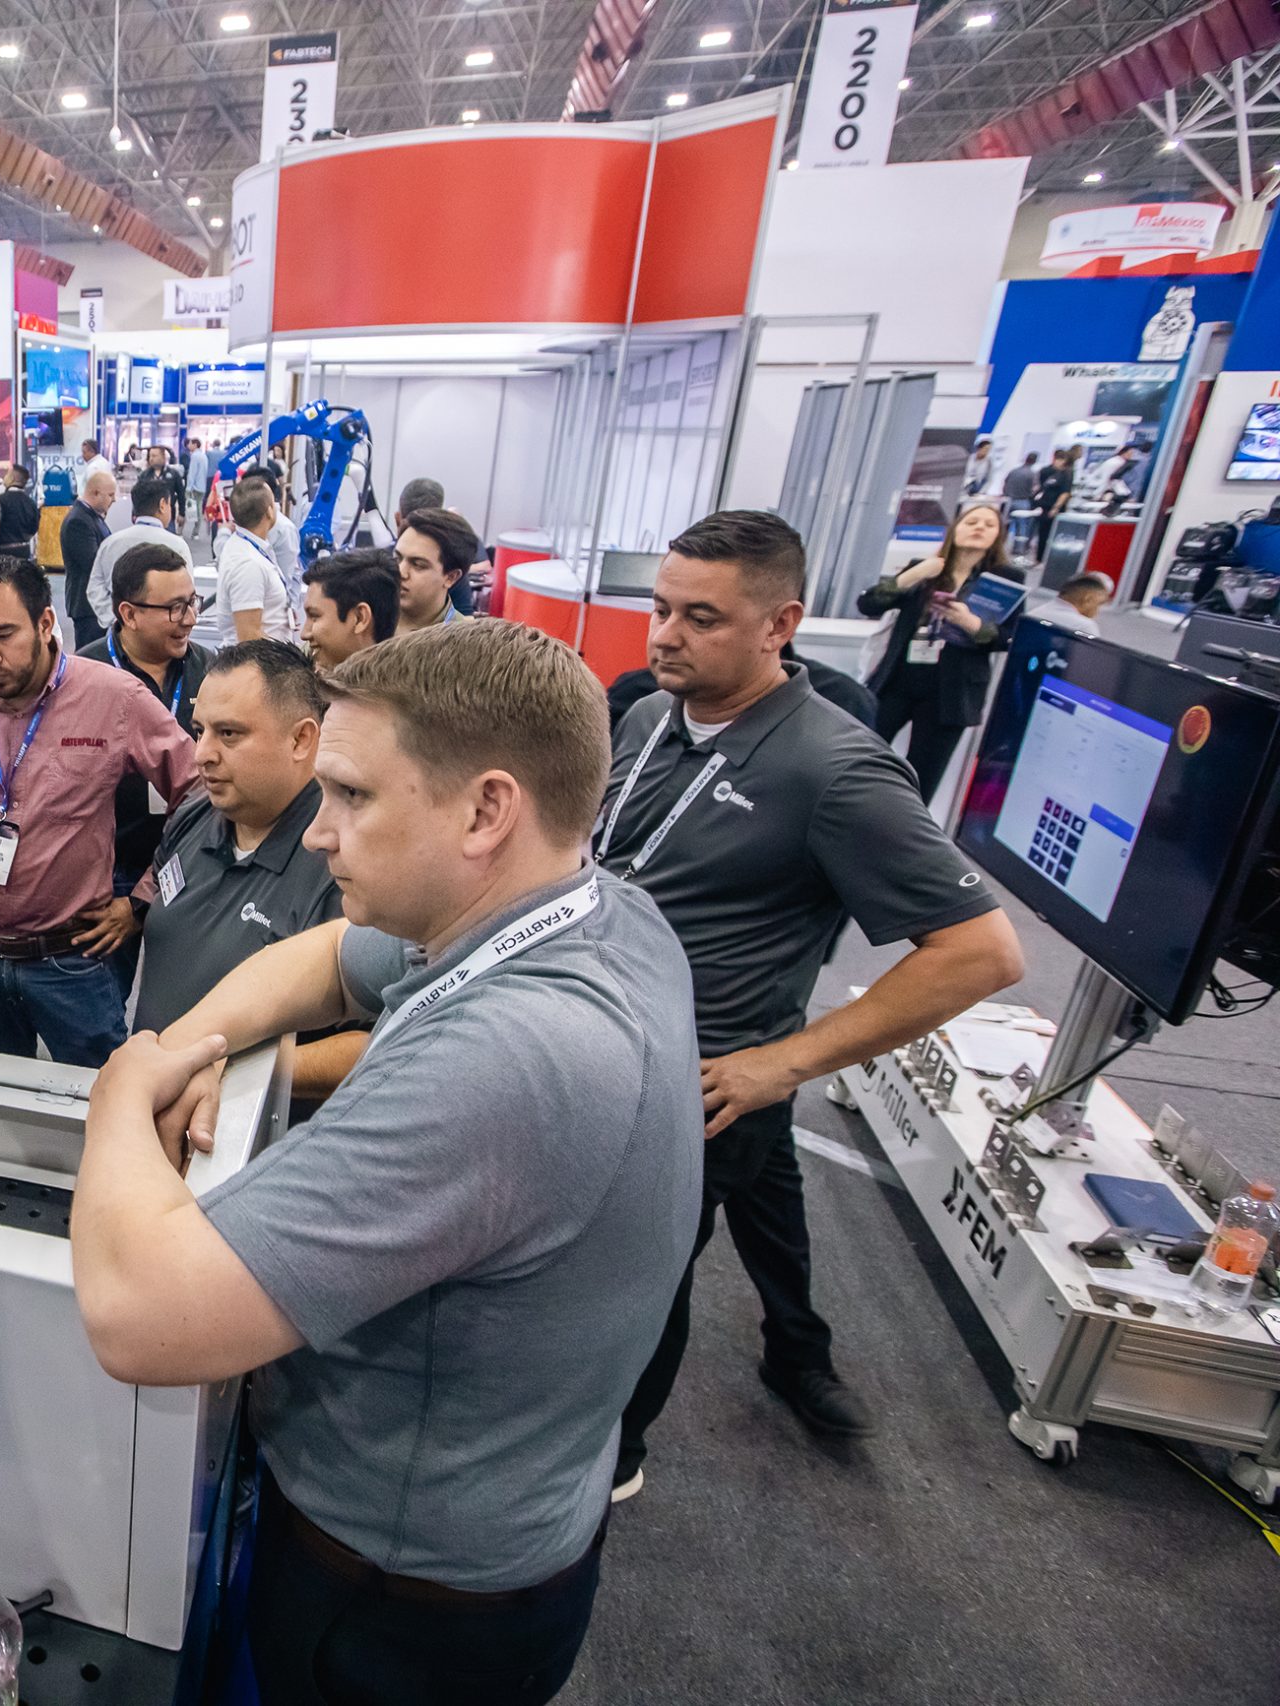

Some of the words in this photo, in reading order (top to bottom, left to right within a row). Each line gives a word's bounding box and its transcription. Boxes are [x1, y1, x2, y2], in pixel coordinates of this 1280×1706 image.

[284, 45, 332, 59] FABTECH
[834, 27, 877, 150] 2200
[61, 738, 104, 747] CATERPILLAR
[686, 770, 712, 802] FABTECH
[253, 910, 272, 928] Miller
[494, 911, 562, 955] FABTECH
[875, 1071, 920, 1147] Miller
[958, 1192, 1007, 1280] FEM
